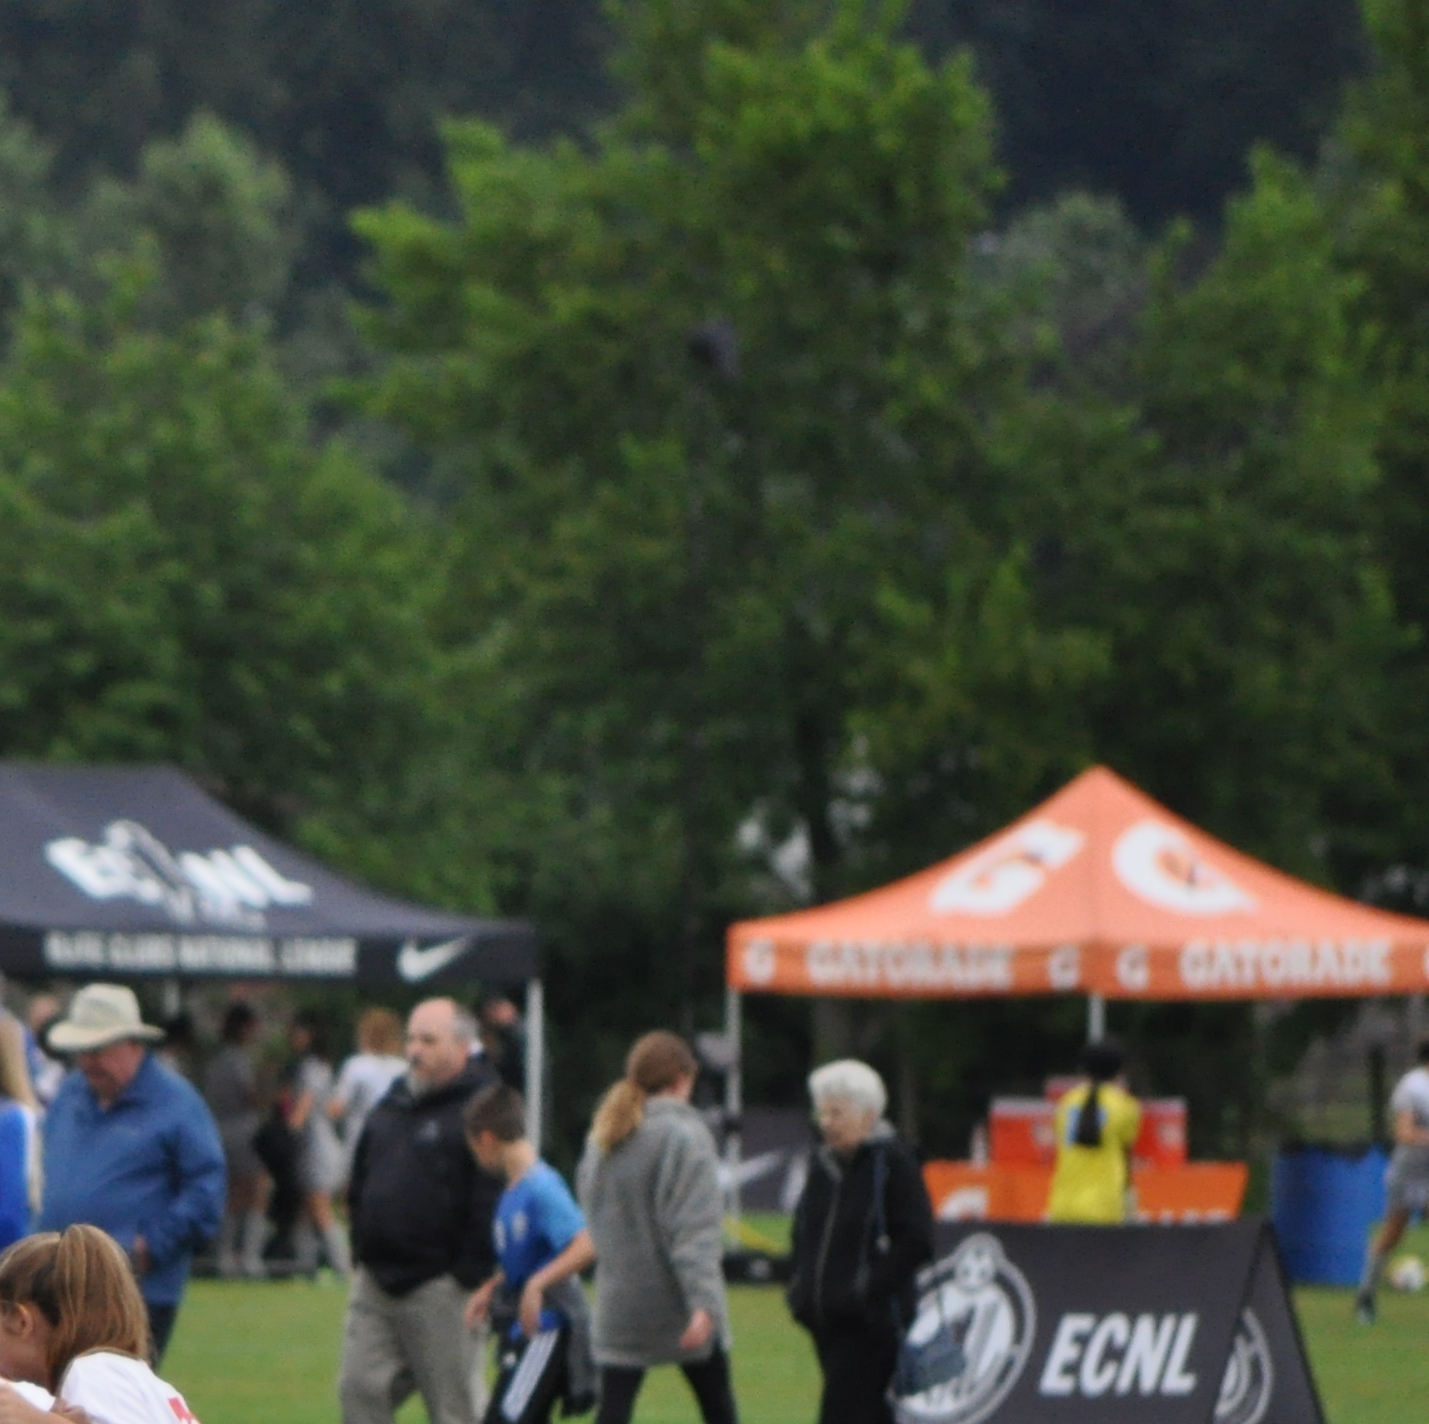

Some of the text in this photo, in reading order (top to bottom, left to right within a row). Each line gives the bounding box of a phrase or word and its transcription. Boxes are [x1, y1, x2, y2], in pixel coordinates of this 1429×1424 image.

[807, 940, 1011, 990] GATORADE
[1178, 938, 1392, 990] GATORADE
[1039, 1311, 1198, 1397] ECNL
